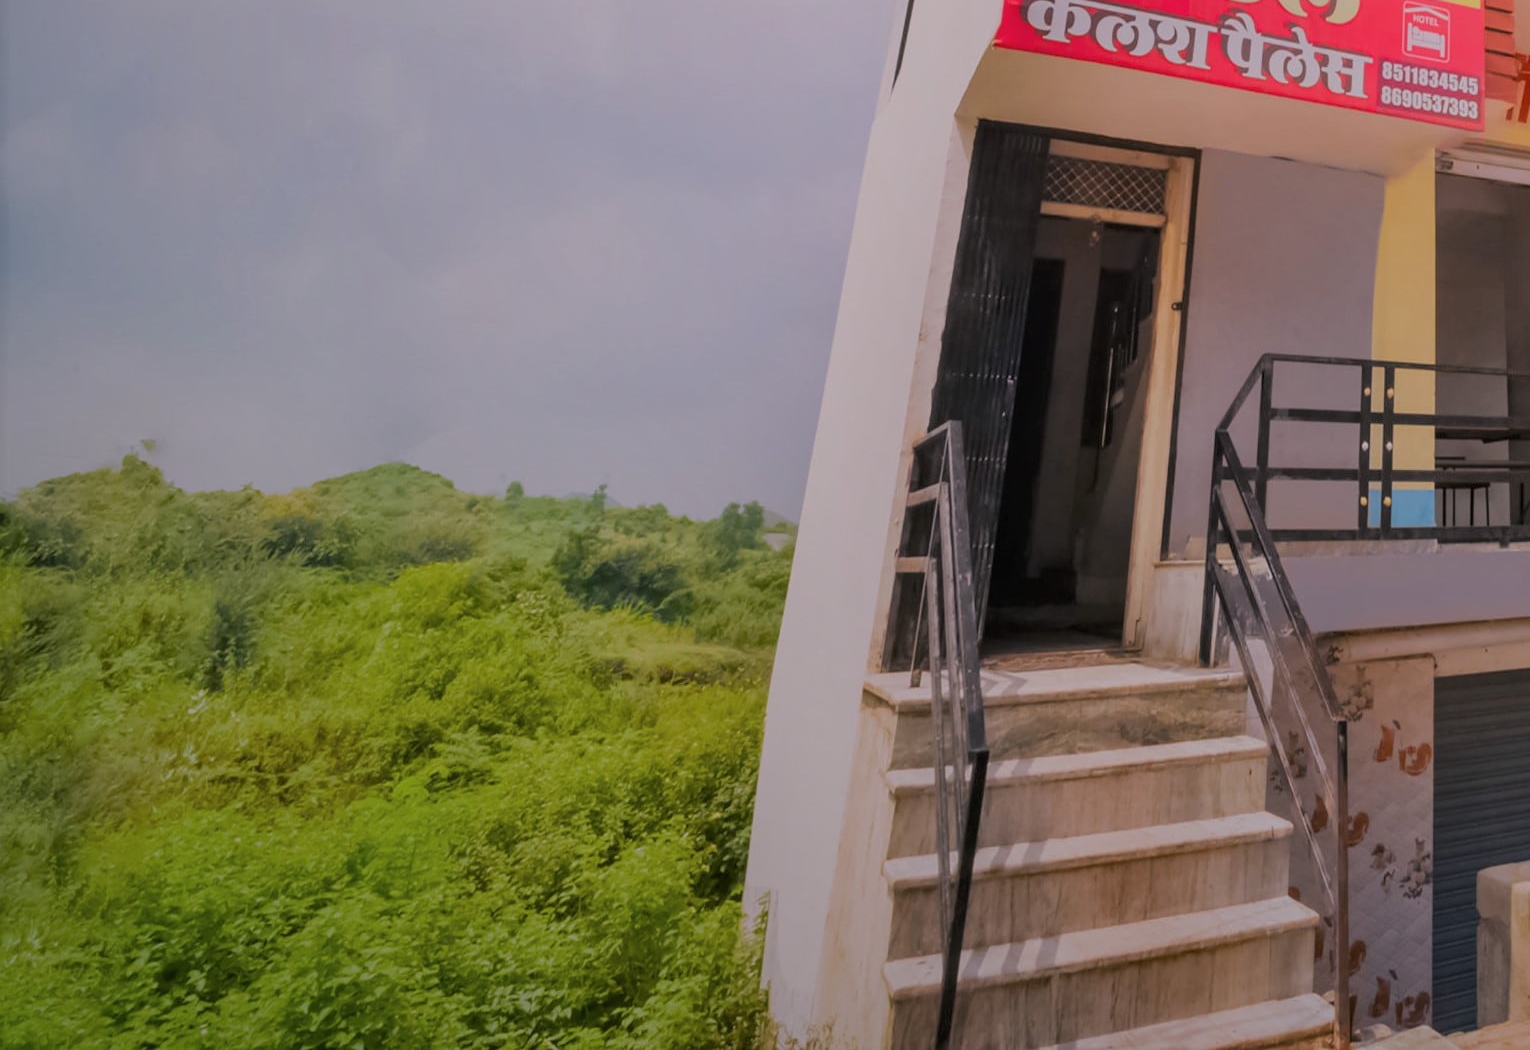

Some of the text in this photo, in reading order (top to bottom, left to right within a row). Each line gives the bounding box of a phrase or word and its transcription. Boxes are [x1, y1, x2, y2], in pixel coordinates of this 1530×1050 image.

[1412, 13, 1440, 28] HOTEL
[1218, 10, 1374, 99] पैलेस
[1381, 60, 1479, 96] 8511834545
[1380, 85, 1479, 120] 8690537393
